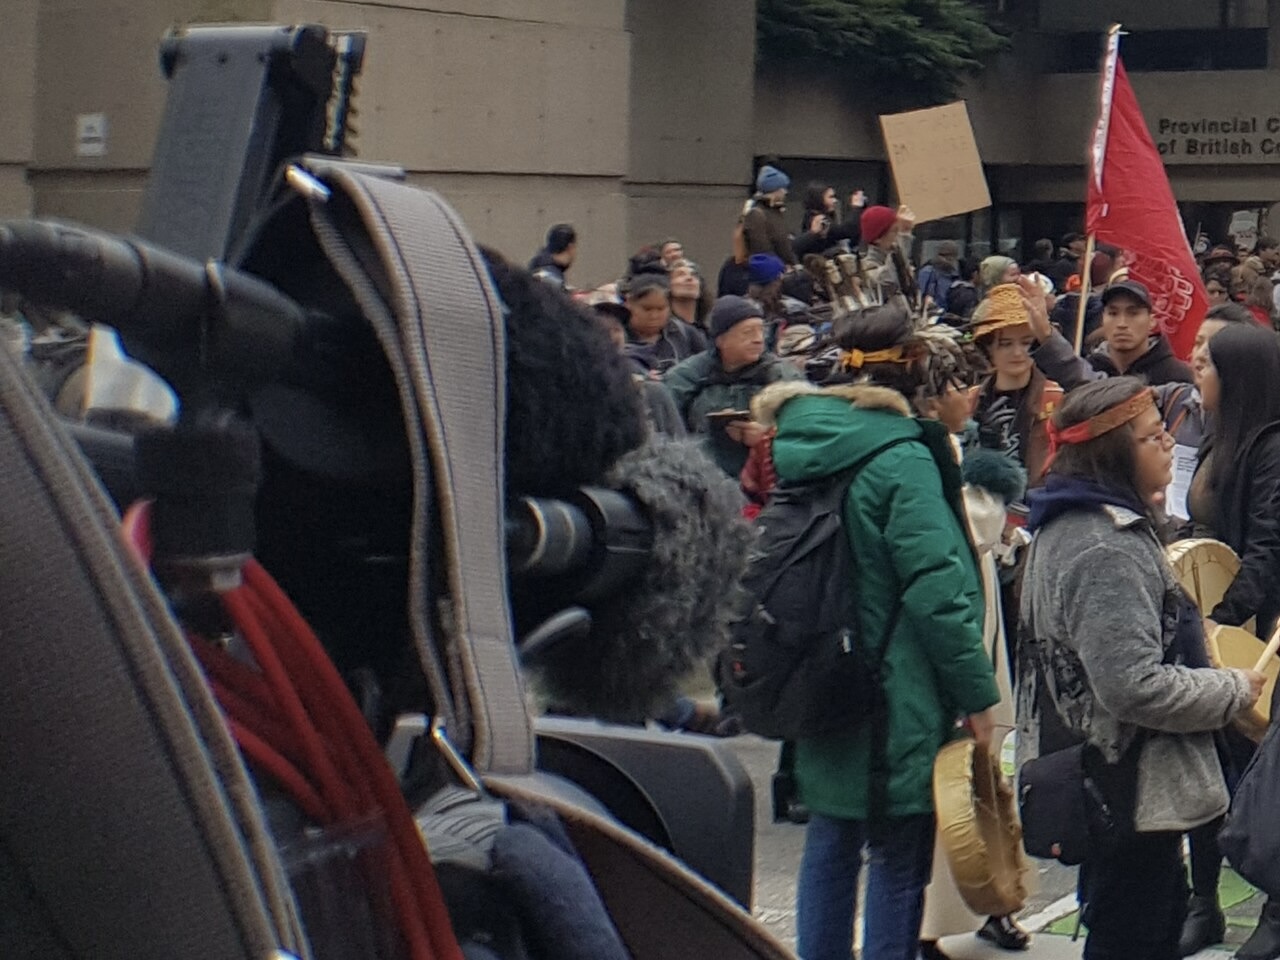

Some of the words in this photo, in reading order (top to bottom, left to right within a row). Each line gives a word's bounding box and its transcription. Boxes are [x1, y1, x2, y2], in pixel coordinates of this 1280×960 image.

[1158, 117, 1257, 134] Provincial
[1158, 138, 1177, 155] of
[1185, 138, 1253, 155] British
